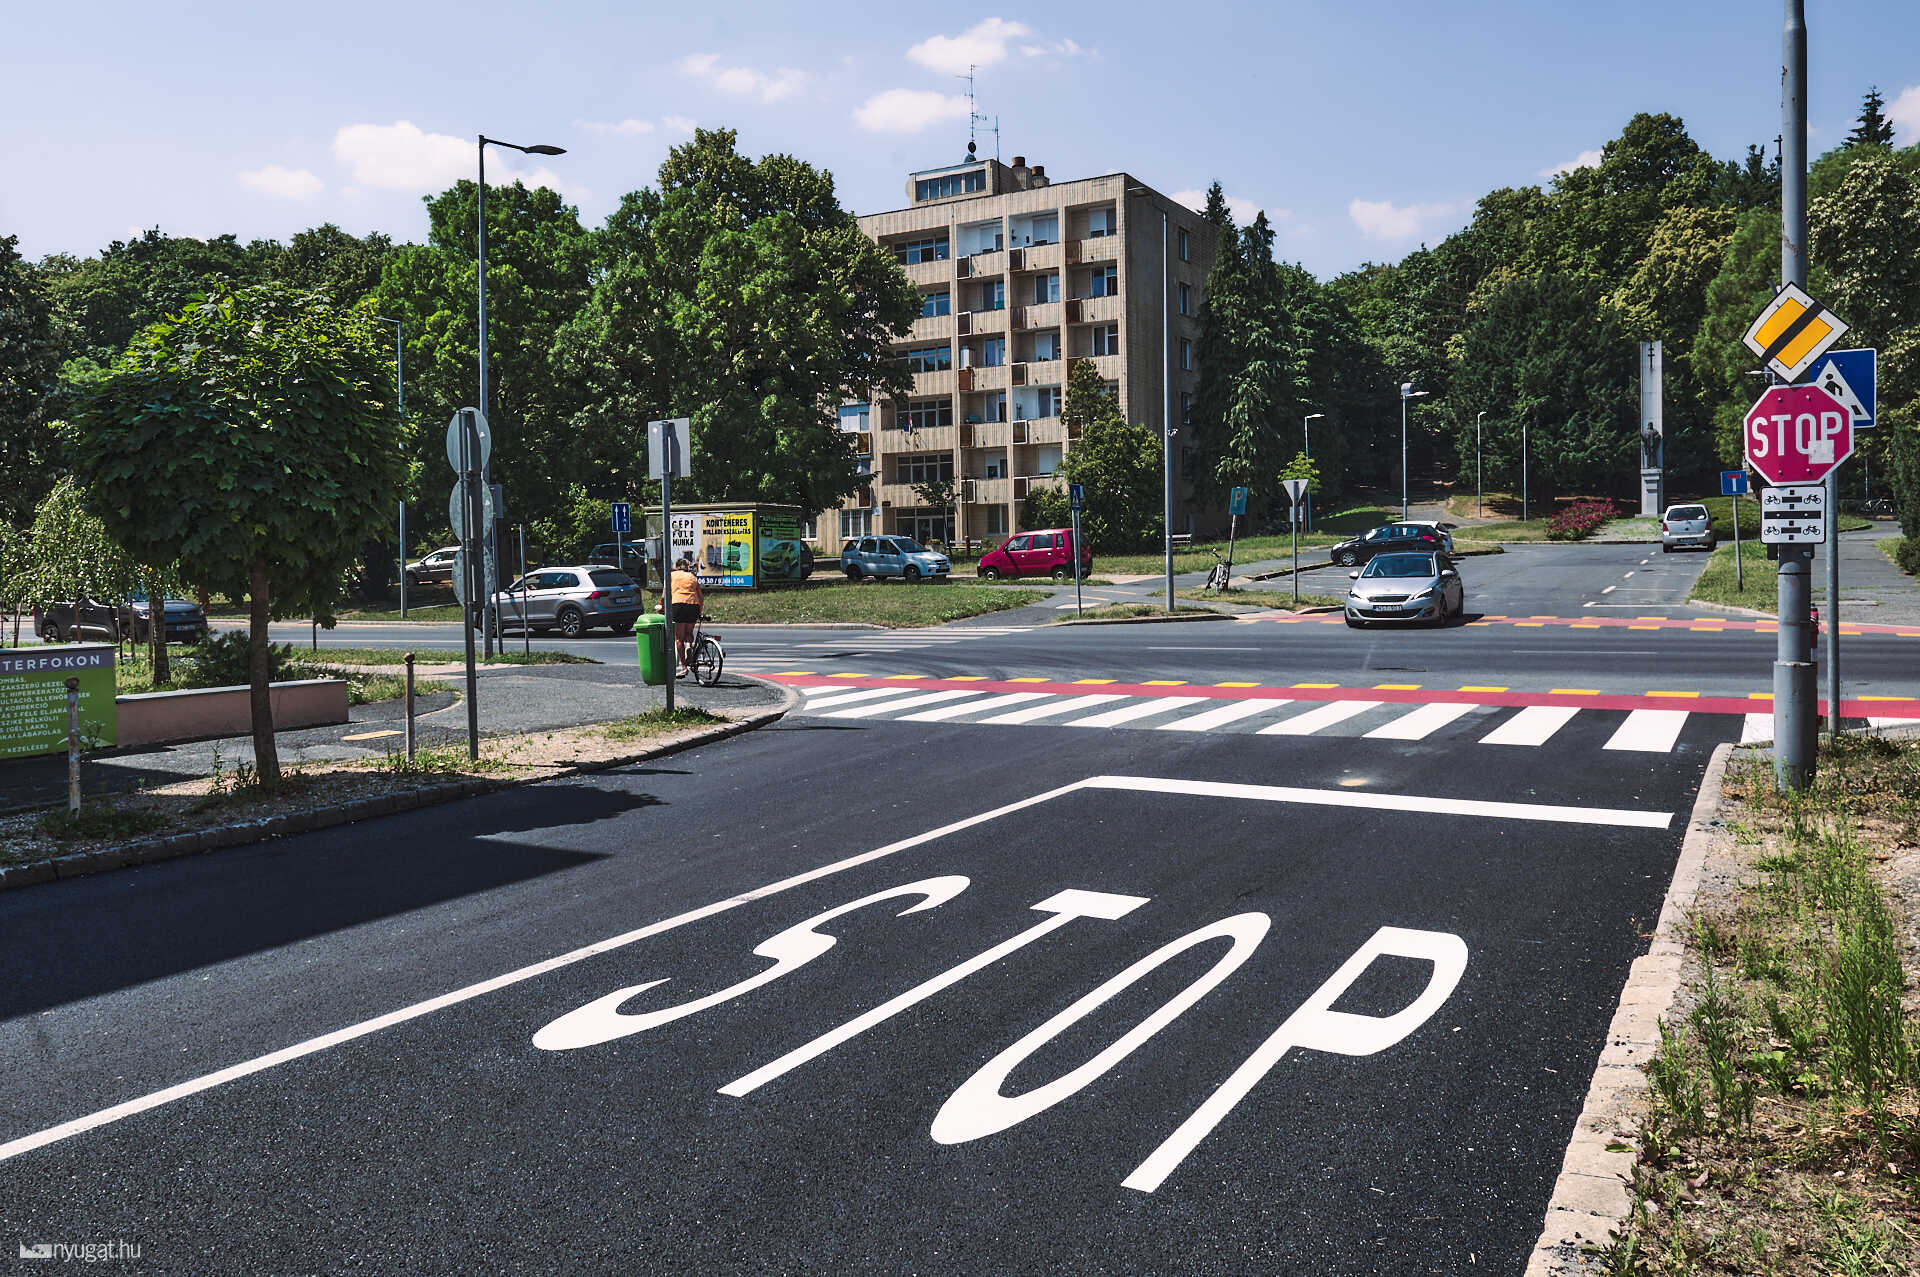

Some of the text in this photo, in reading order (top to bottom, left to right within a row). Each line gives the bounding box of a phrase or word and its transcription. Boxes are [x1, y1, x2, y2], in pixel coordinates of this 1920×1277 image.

[1751, 411, 1843, 458] STOP
[706, 518, 748, 527] KONTÉNERES
[672, 538, 694, 547] MUNKA
[2, 655, 100, 672] TERFOKON
[10, 686, 70, 698] HIPERKERATÓZI
[532, 875, 1469, 1195] STOP
